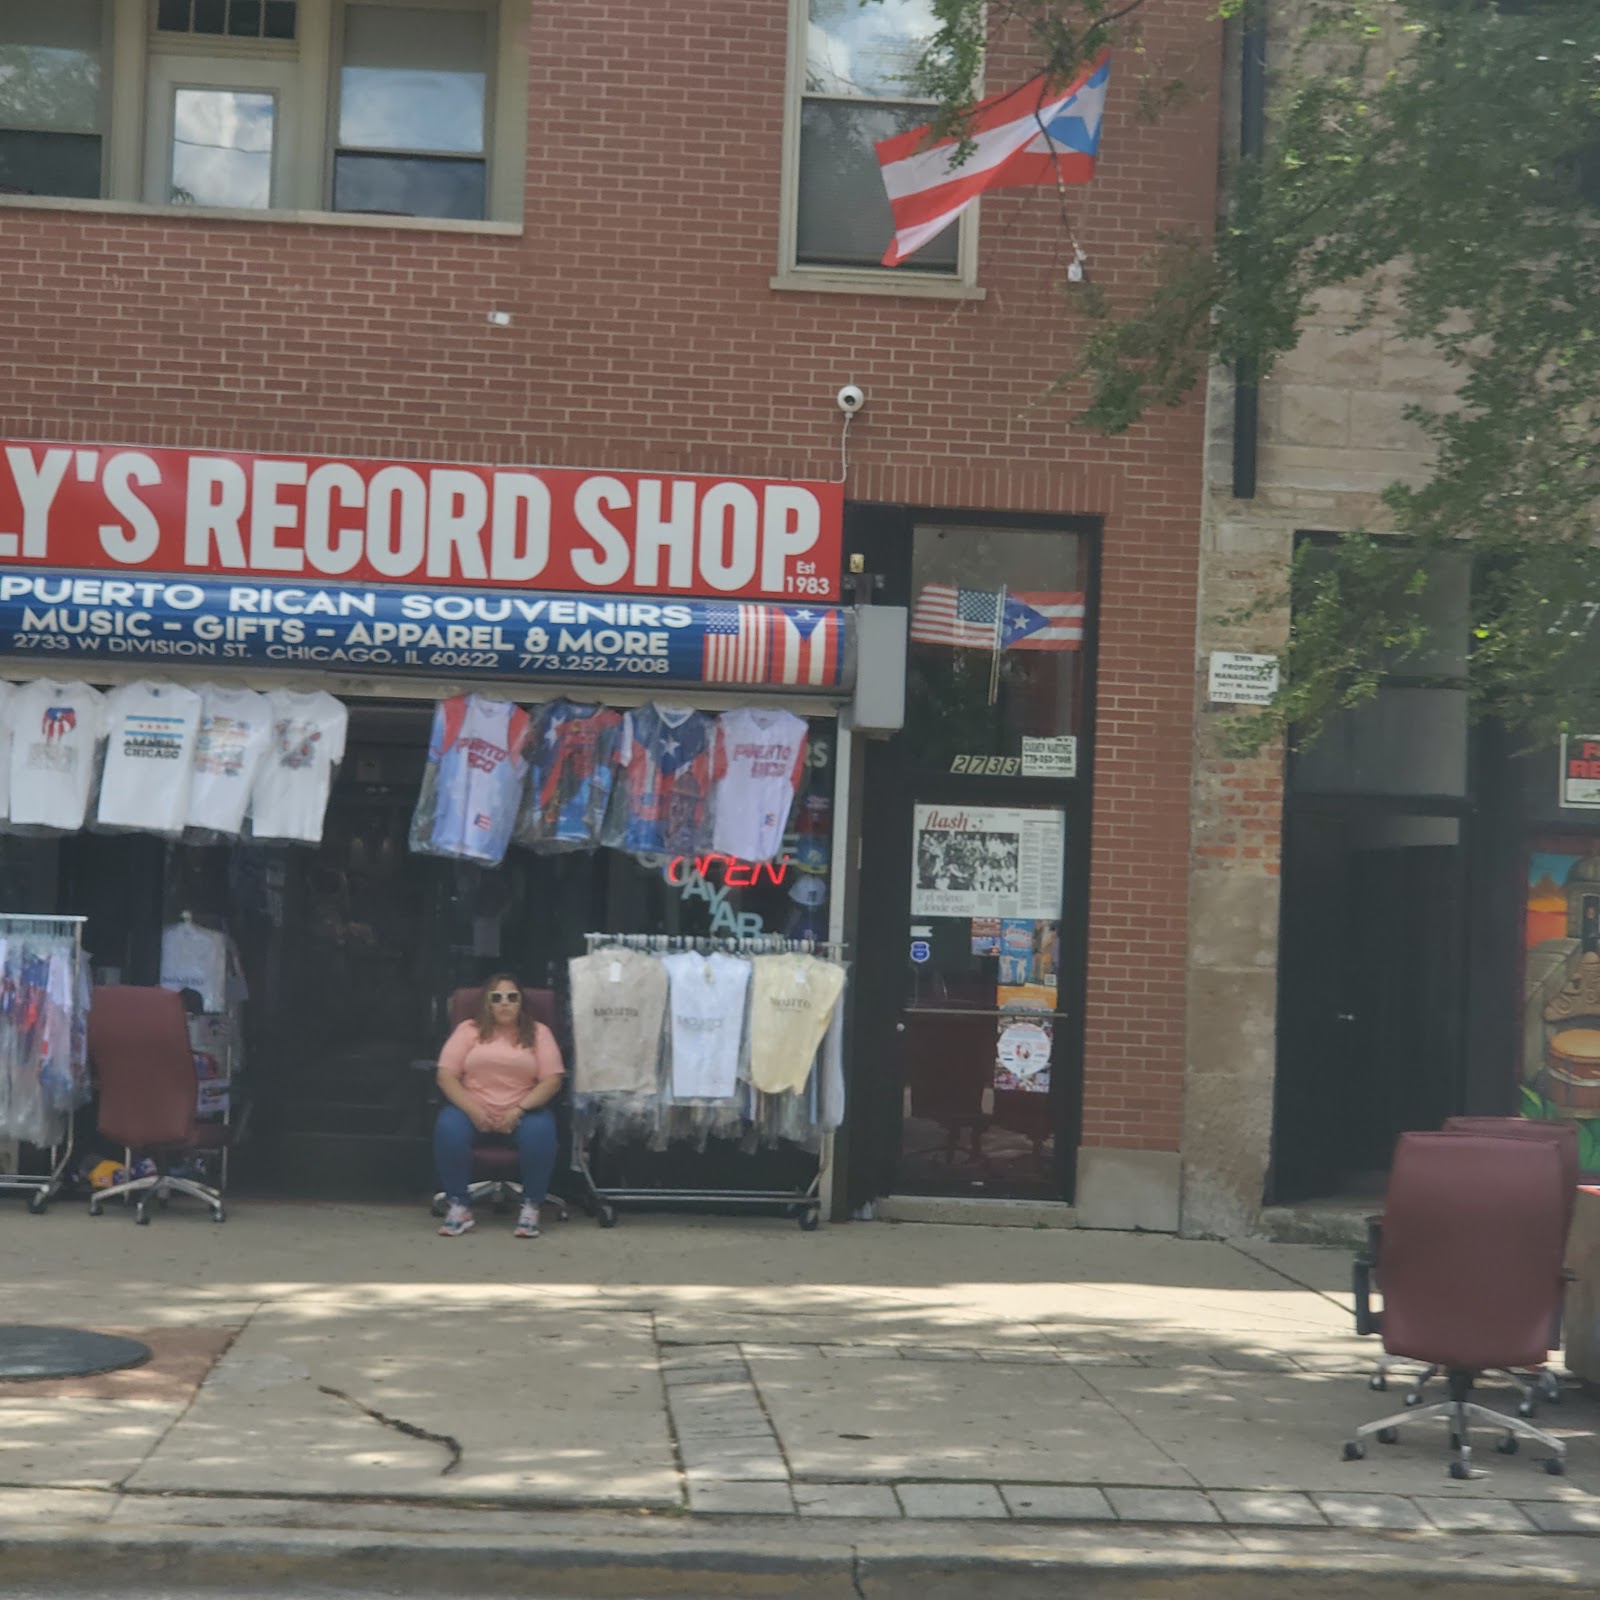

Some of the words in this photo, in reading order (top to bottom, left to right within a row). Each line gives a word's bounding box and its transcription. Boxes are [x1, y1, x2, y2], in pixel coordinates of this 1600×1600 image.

[0, 447, 162, 564] Y'S
[184, 456, 551, 581] RECORD
[570, 476, 820, 592] SHOP
[796, 561, 816, 575] Est
[786, 576, 830, 595] 1983
[0, 576, 205, 610] PUERTO
[229, 587, 376, 618] RICAN
[401, 595, 693, 628] SOUVENIRS
[22, 607, 152, 637] MUSIC
[193, 615, 305, 643] GIFTS
[344, 622, 514, 651] APPAREL
[525, 630, 549, 651] &
[557, 628, 670, 657] MORE
[13, 633, 70, 651] 2733
[76, 636, 101, 650] W
[108, 637, 216, 656] DIVISION
[223, 644, 251, 658] ST.
[266, 645, 398, 665] CHICAGO,
[404, 651, 423, 665] IL
[430, 650, 499, 667] 60622
[519, 654, 670, 674] 773.252.7008
[1222, 664, 1271, 672] PROPERT
[953, 756, 1019, 775] 2733
[925, 810, 968, 831] flash
